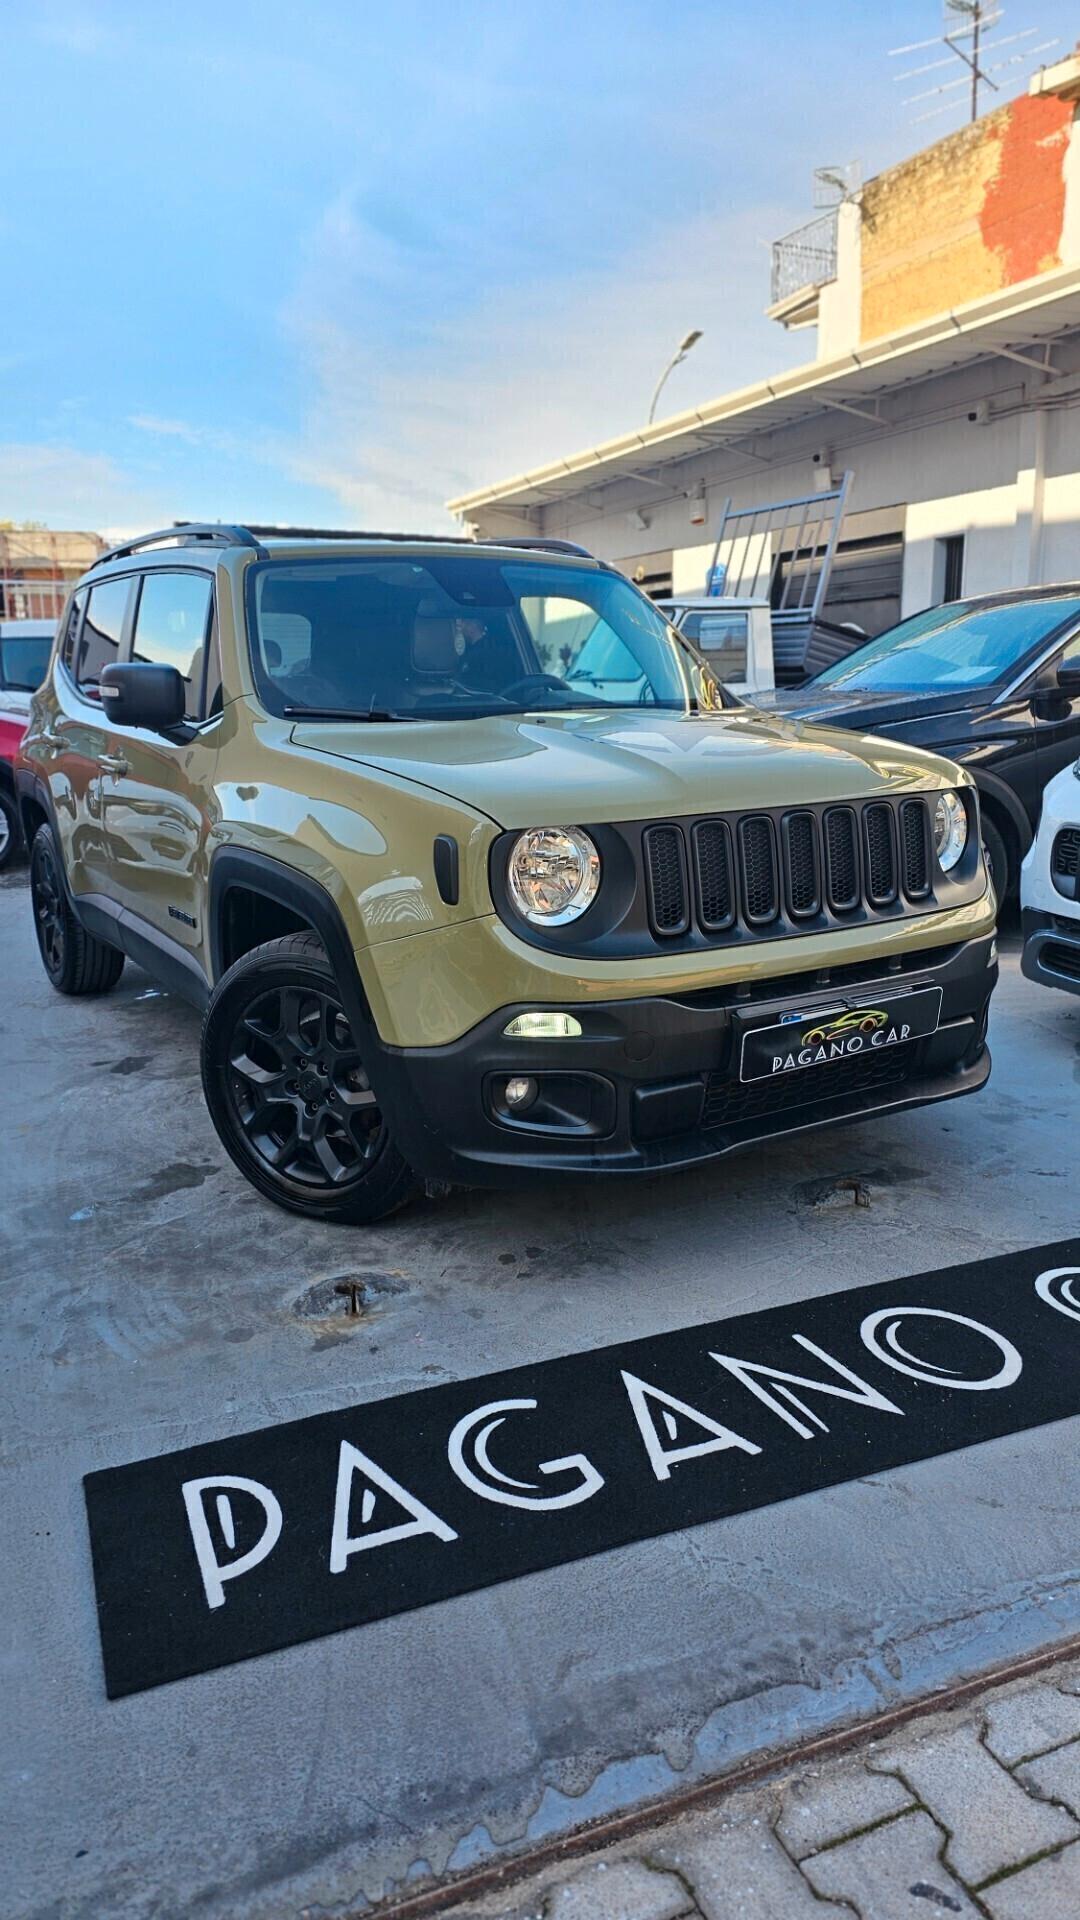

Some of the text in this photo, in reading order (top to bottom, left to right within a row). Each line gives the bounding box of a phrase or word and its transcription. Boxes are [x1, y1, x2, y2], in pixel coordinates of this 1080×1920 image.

[772, 1024, 911, 1073] PAGANO CAR
[181, 1306, 1023, 1609] PAGANO
